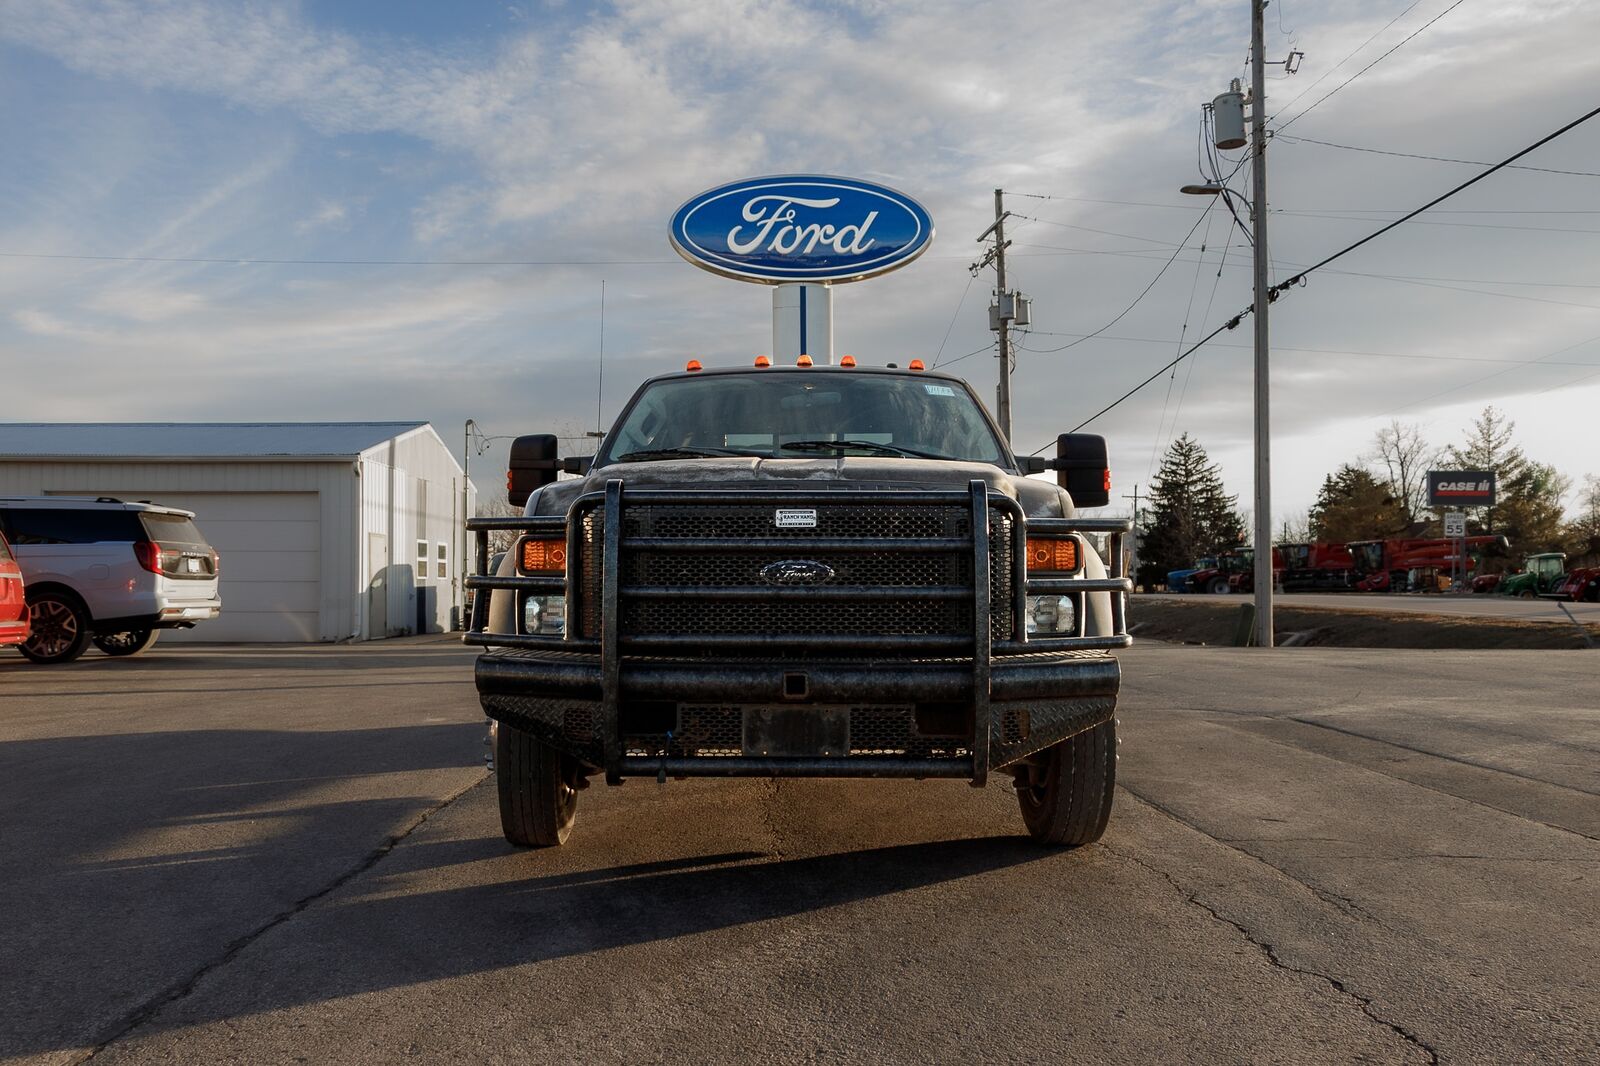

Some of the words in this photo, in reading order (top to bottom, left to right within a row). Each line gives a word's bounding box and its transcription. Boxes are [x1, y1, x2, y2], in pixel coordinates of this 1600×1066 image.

[727, 195, 879, 255] Ford
[1437, 481, 1476, 491] CASE
[1446, 525, 1463, 534] 55
